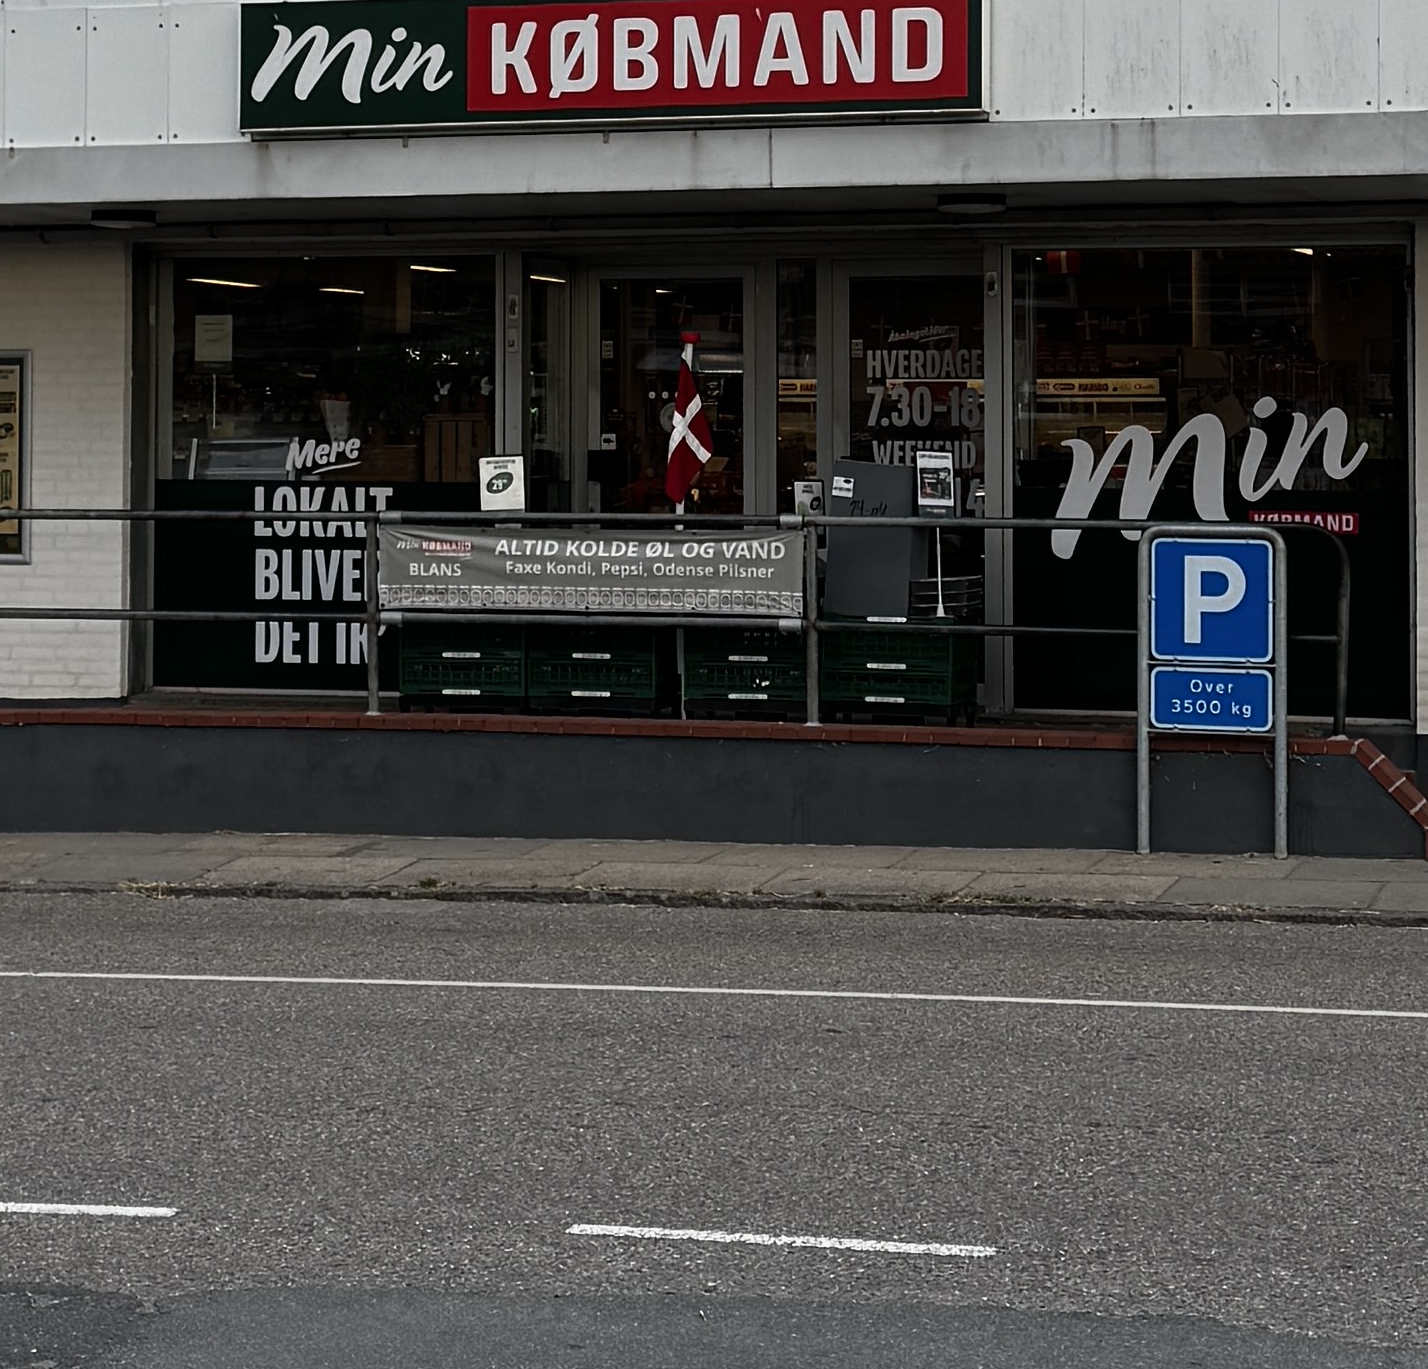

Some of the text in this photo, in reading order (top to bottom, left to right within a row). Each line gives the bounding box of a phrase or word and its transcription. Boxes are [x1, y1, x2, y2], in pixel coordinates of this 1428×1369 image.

[250, 6, 945, 104] Min KØBMAND
[866, 348, 983, 379] HVERDAGE
[865, 385, 982, 428] 7.30-18
[285, 437, 362, 472] Mere
[1050, 395, 1369, 560] Min
[494, 538, 786, 560] ALTID KOLDE ØL OG VAND
[254, 548, 380, 602] BLIVE
[409, 562, 462, 577] BLANS
[506, 560, 775, 579] Faxe Kondi, Pepsi, Odense Pilsner
[1183, 555, 1247, 644] P
[1189, 678, 1234, 694] Over
[1171, 699, 1252, 719] 3500 kg
